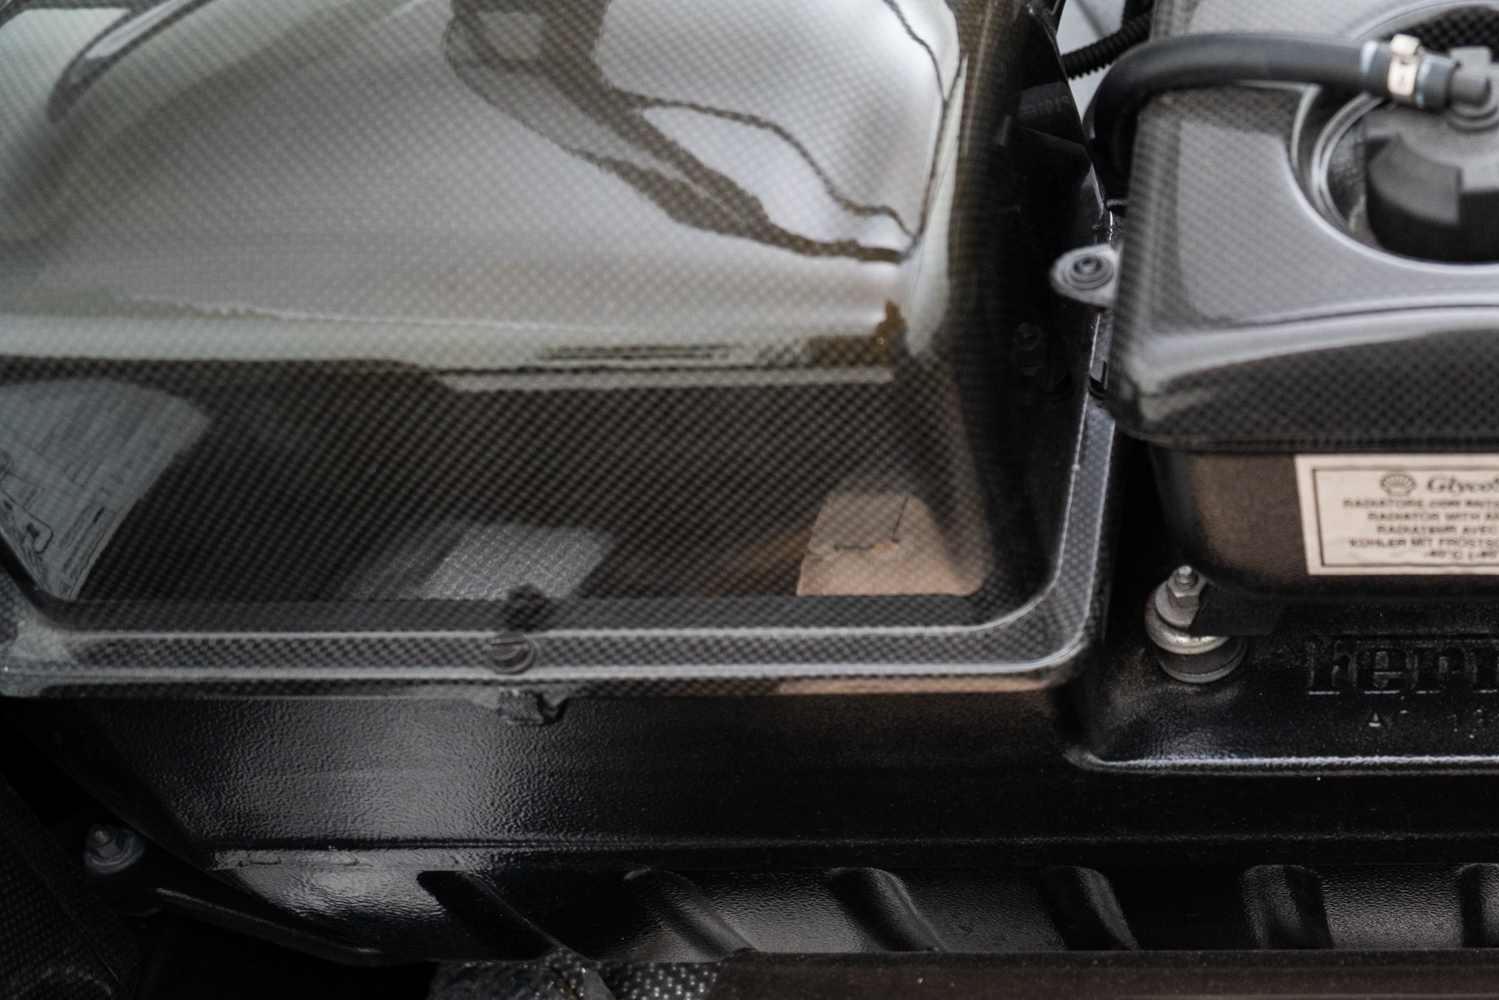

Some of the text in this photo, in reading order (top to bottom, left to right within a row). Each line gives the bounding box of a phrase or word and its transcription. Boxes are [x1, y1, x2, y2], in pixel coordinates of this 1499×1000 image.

[1344, 498, 1424, 508] RADIATORE
[1368, 512, 1439, 522] RADIATOR
[1446, 512, 1479, 522] WITH
[1462, 525, 1498, 535] AVEC
[1412, 538, 1433, 548] MIT
